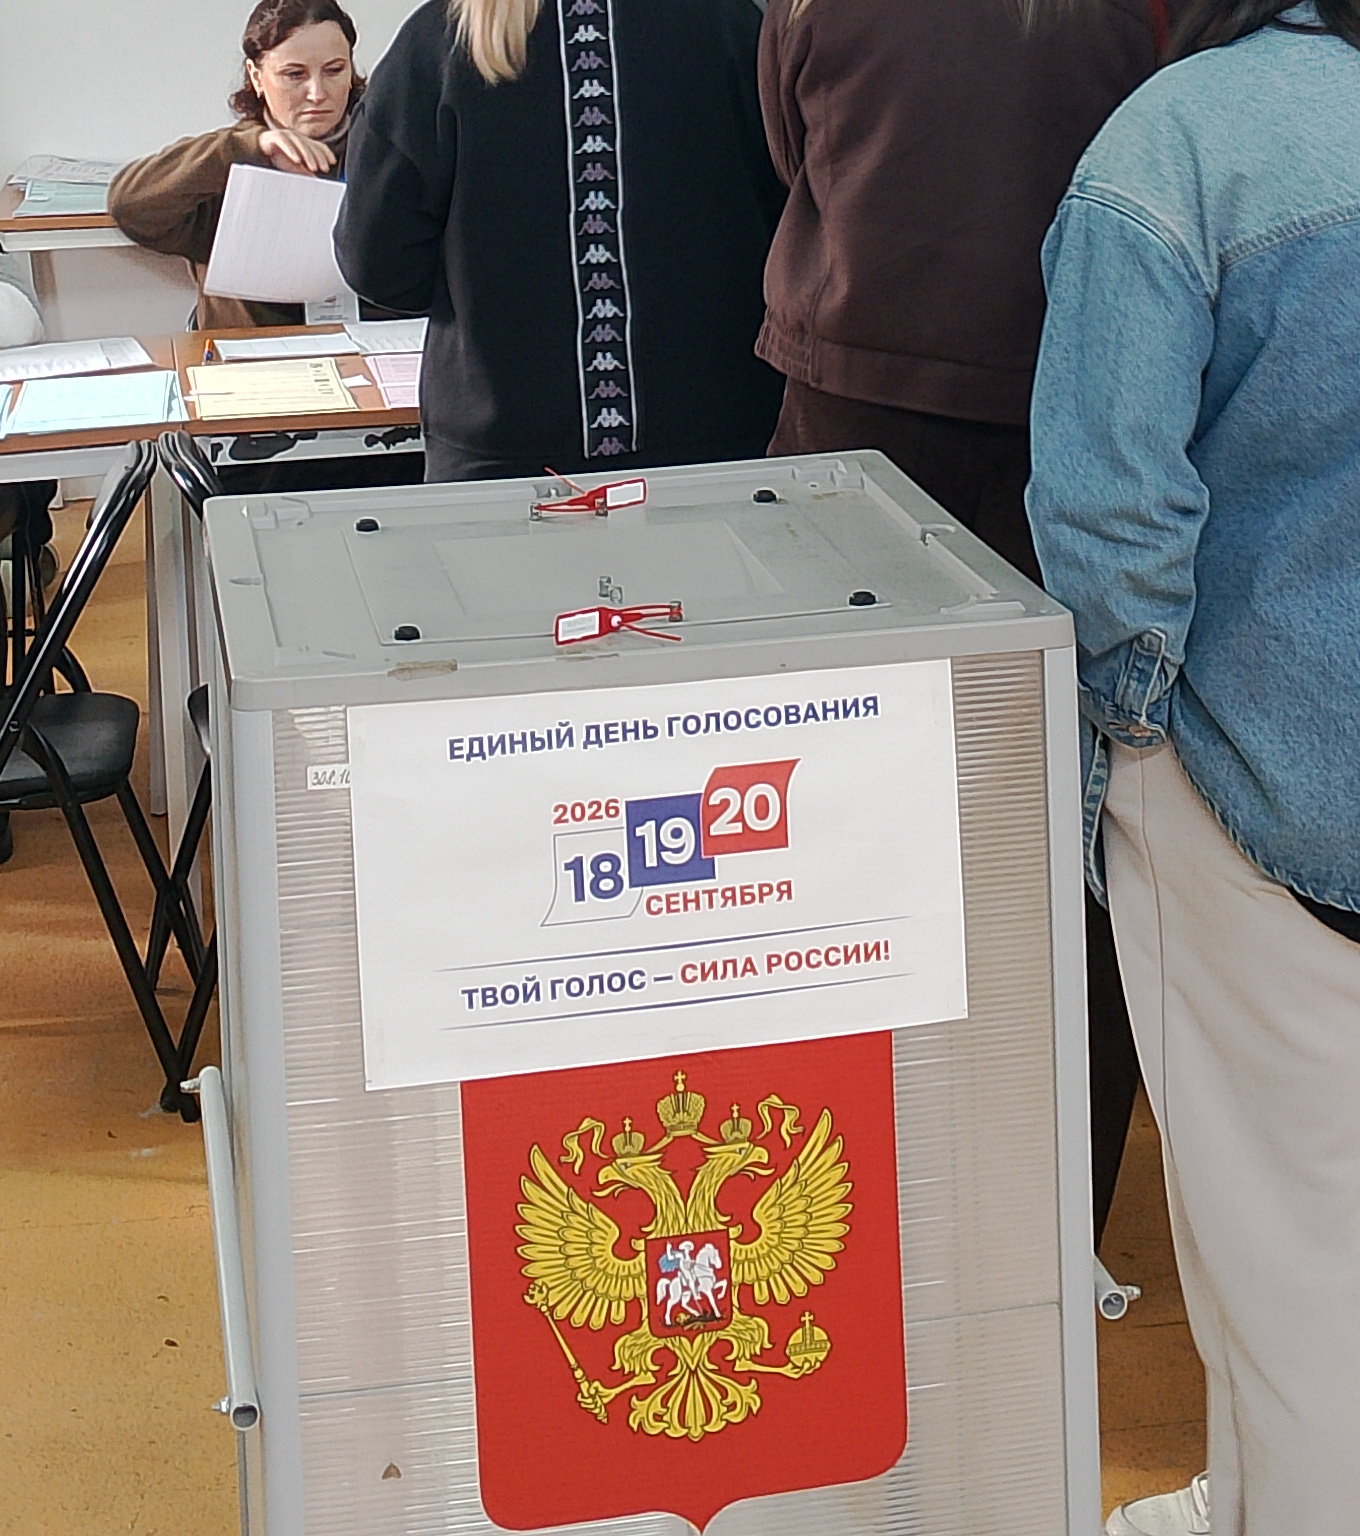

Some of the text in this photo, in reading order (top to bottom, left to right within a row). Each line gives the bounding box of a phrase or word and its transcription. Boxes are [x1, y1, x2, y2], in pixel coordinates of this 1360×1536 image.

[448, 695, 880, 762] ЕДИНЫЙ ДЕНЬ ГОЛОСОВАНИЯ
[553, 799, 620, 825] 2026
[564, 783, 781, 902] 18 19 20
[645, 880, 793, 916] СЕНТЯБРЯ
[461, 976, 541, 1010] ТВОЙ
[550, 969, 647, 1001] ГОЛОС
[680, 955, 758, 985] СИЛА
[766, 939, 890, 975] РОССИИ!
